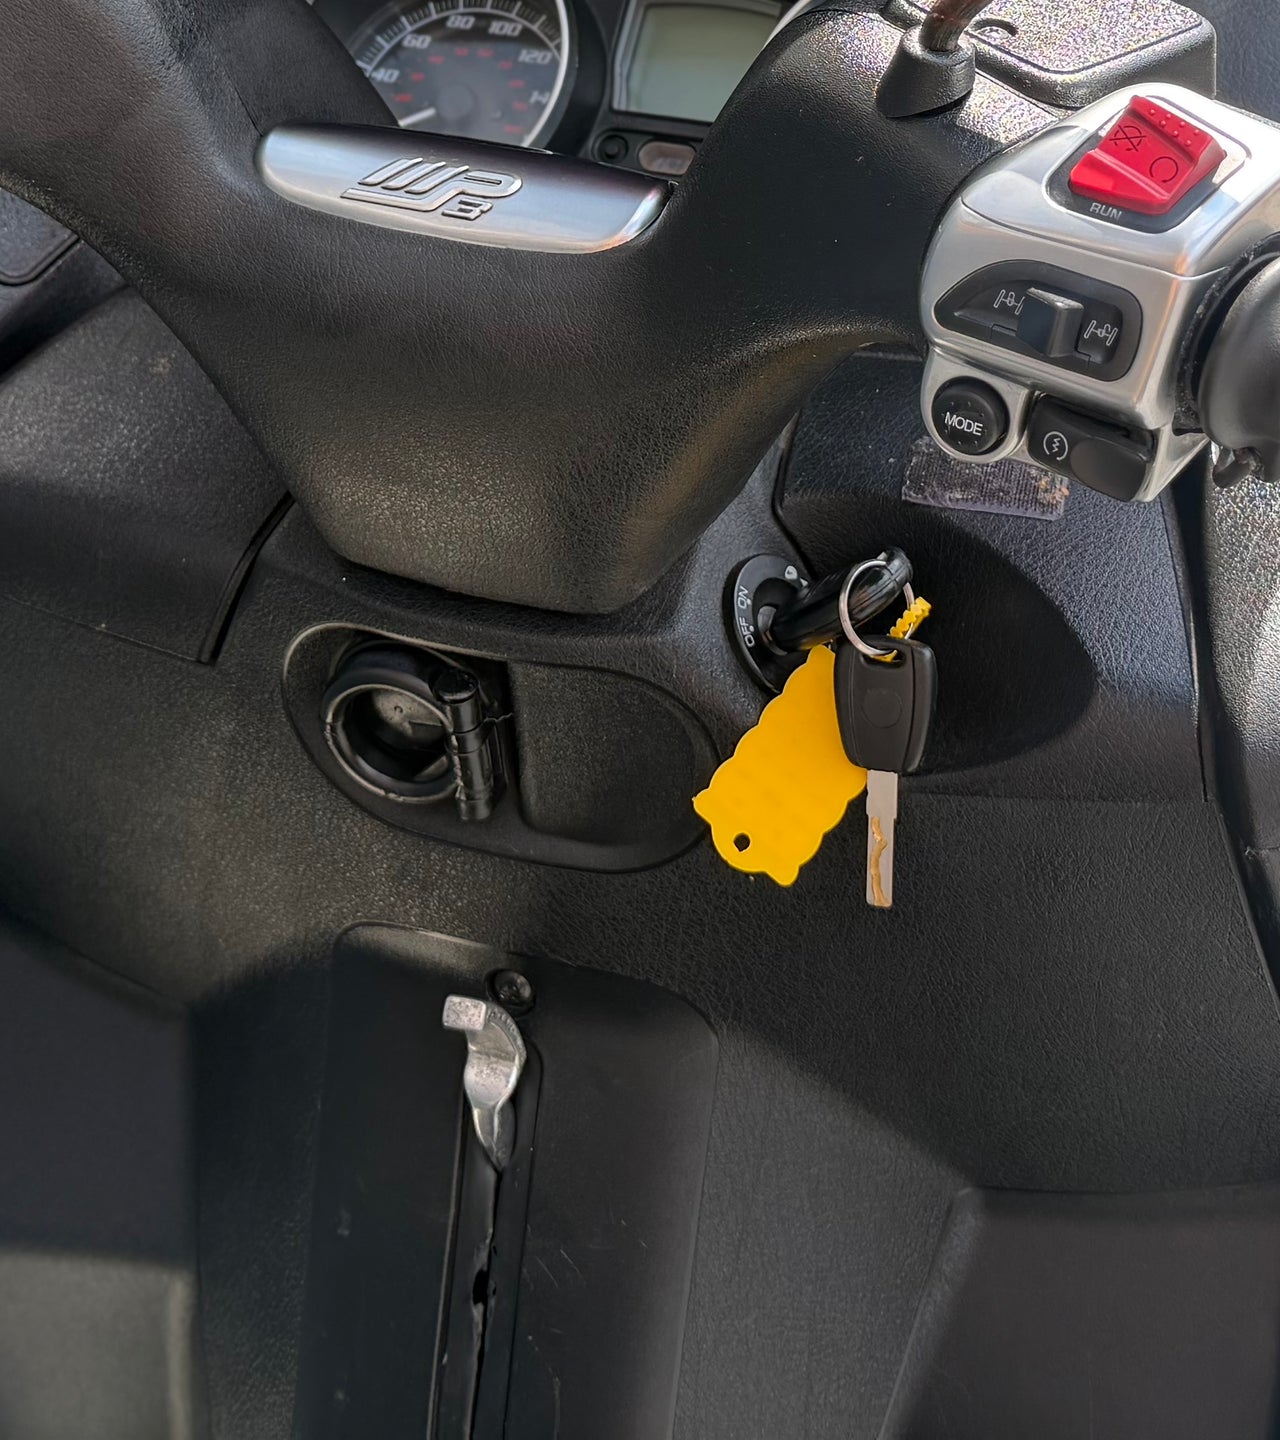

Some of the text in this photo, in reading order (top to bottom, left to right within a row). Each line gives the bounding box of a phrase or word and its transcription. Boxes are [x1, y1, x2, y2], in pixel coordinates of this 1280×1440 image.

[446, 15, 475, 30] 80
[488, 20, 523, 37] 100
[401, 34, 432, 50] 60
[518, 49, 553, 64] 120
[1089, 202, 1123, 221] RUN
[944, 411, 983, 436] MODE
[737, 586, 749, 609] ON
[740, 617, 756, 648] OFF
